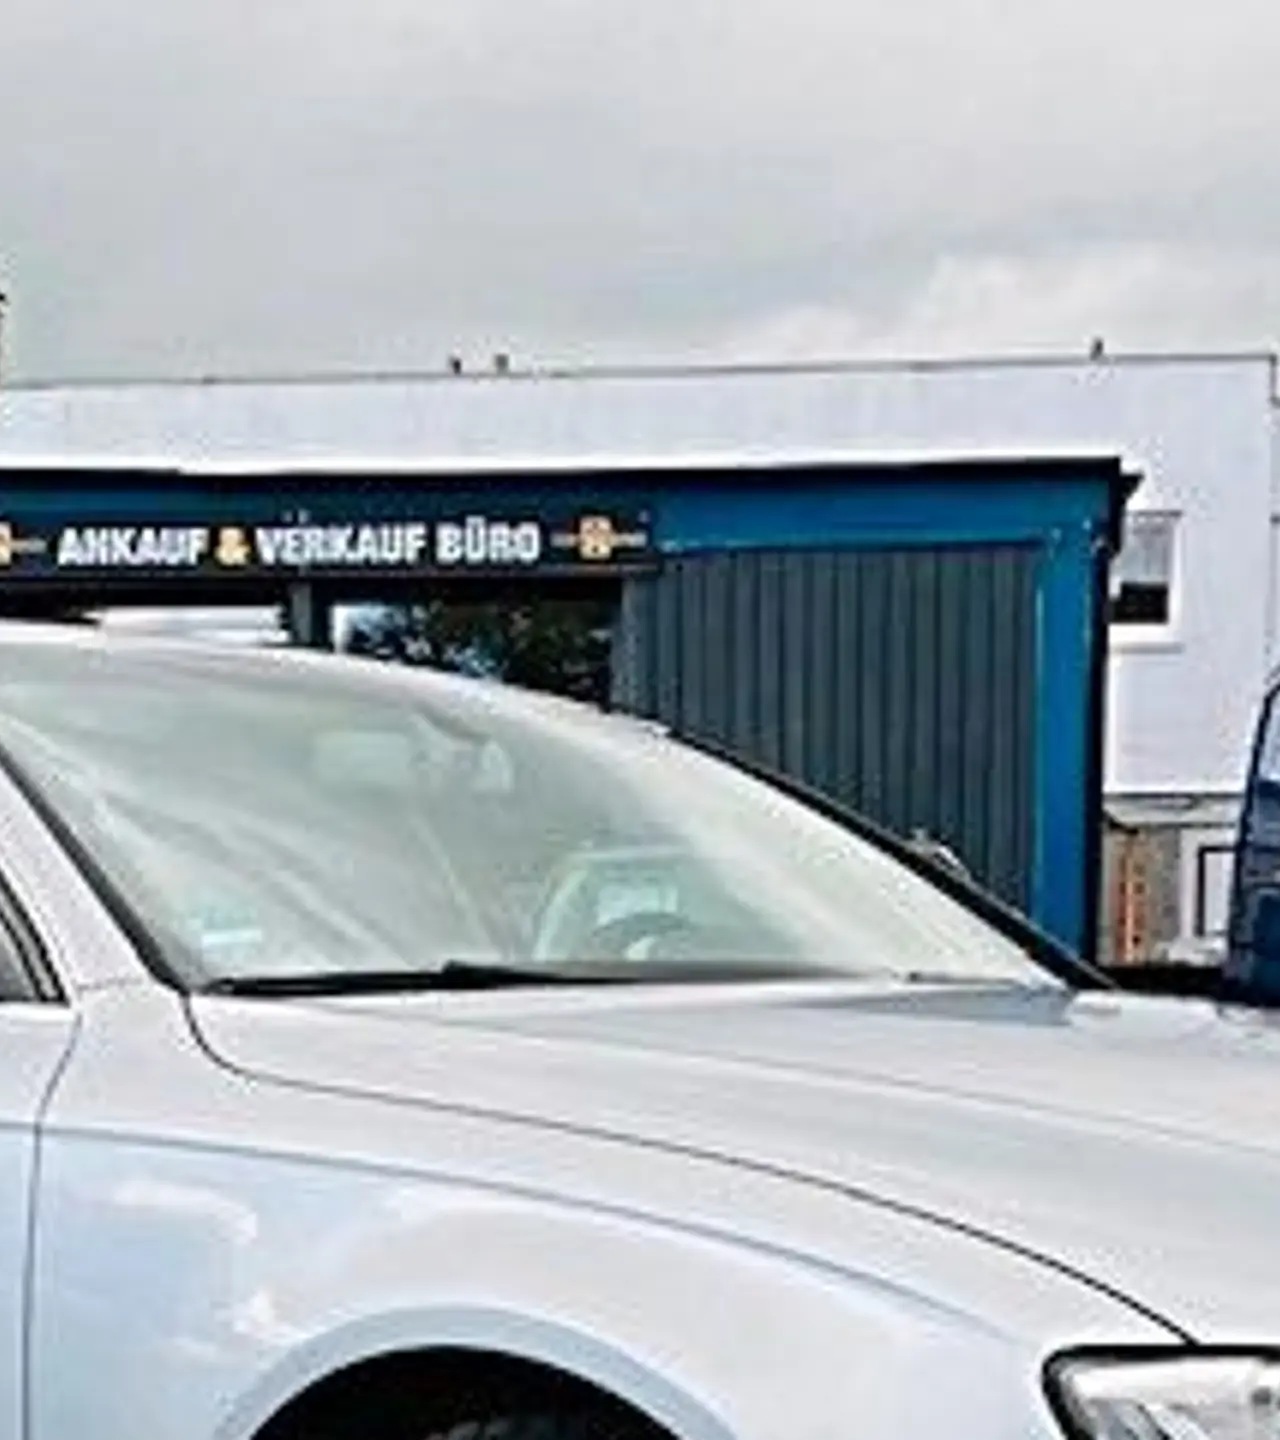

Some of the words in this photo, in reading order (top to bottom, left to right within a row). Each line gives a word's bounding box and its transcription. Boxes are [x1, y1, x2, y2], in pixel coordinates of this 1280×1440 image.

[57, 526, 210, 567] ANKAUF
[214, 526, 252, 566] &
[254, 522, 427, 566] VERKAUF
[435, 514, 541, 564] BÜRO
